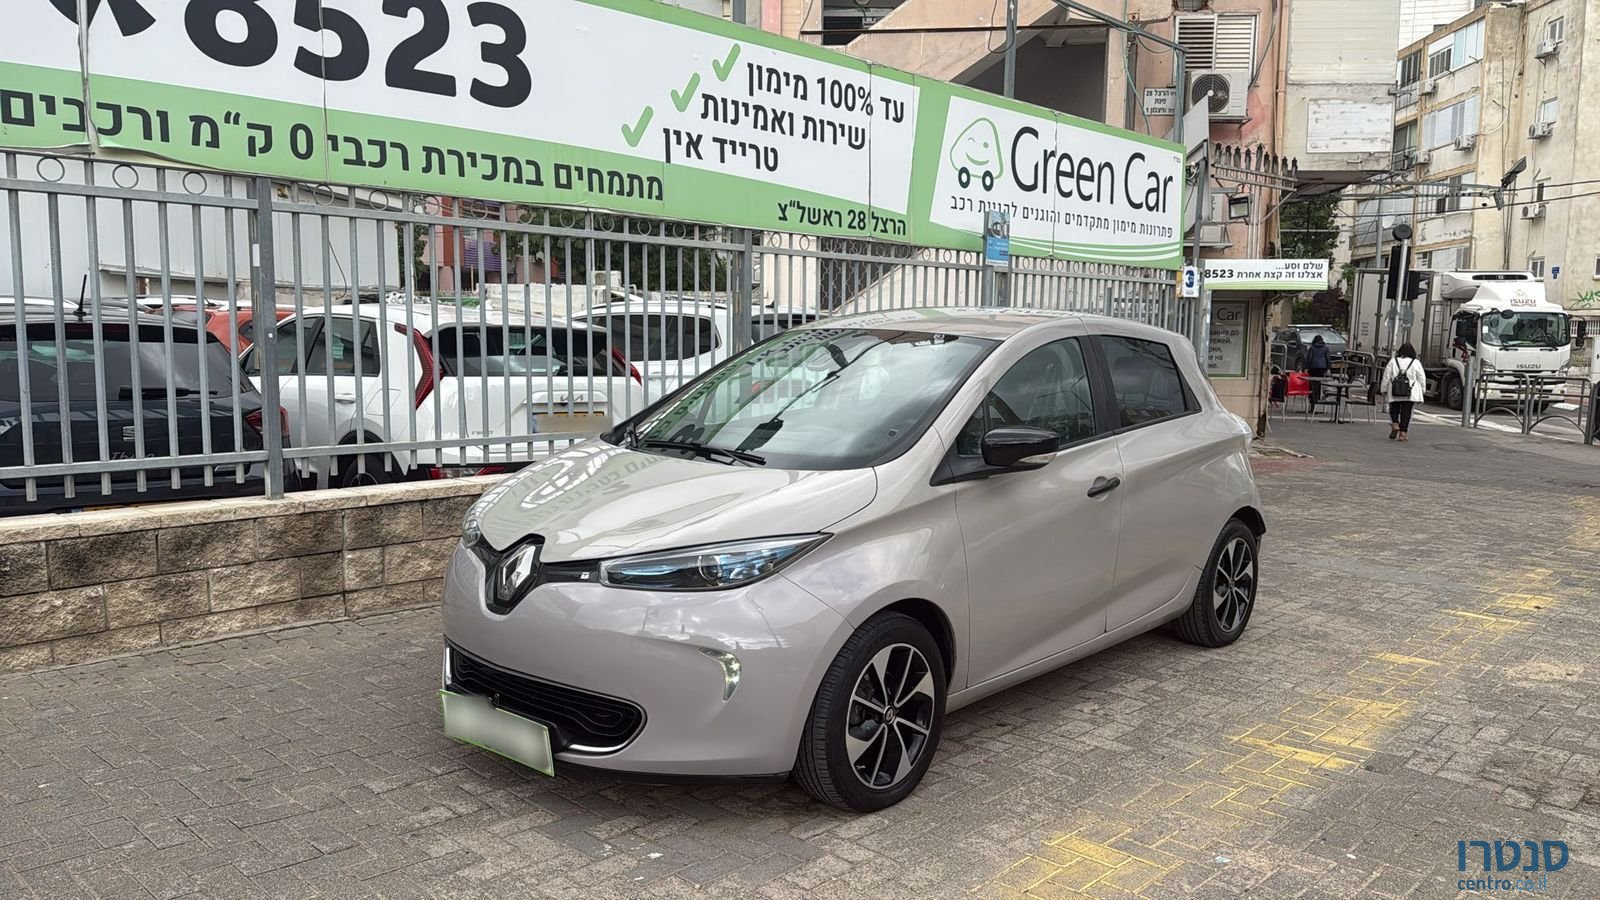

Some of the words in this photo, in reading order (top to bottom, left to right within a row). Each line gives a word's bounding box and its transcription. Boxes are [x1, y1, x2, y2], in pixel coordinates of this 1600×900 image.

[747, 62, 807, 101] מימון
[816, 76, 873, 116] 100%
[880, 96, 904, 123] עד
[0, 89, 170, 143] ורכבים
[701, 93, 794, 137] ואמינות
[189, 110, 273, 158] ק"מ
[290, 123, 314, 160] 0
[663, 127, 703, 163] אין
[801, 114, 866, 150] שירות
[327, 134, 410, 172] רכבי
[422, 145, 544, 187] במכירת
[712, 136, 778, 172] טרייד
[553, 162, 664, 201] מתמחים
[1011, 126, 1115, 206] Green
[1124, 152, 1173, 213] Car
[778, 200, 842, 228] ראשל"צ
[950, 196, 973, 212] רכב
[1023, 206, 1060, 223] והוגנים
[847, 210, 866, 230] 28
[871, 210, 906, 236] הרצל
[1065, 212, 1109, 231] מתקדמים
[1112, 219, 1136, 234] מימון
[1139, 223, 1173, 238] פתרונות
[1204, 269, 1234, 279] 8523
[1236, 271, 1261, 279] אחרת
[1263, 271, 1283, 280] קצת
[1285, 271, 1295, 279] זה
[1297, 270, 1323, 279] אצלנו
[1303, 262, 1323, 270] שלם
[1216, 307, 1242, 321] Car
